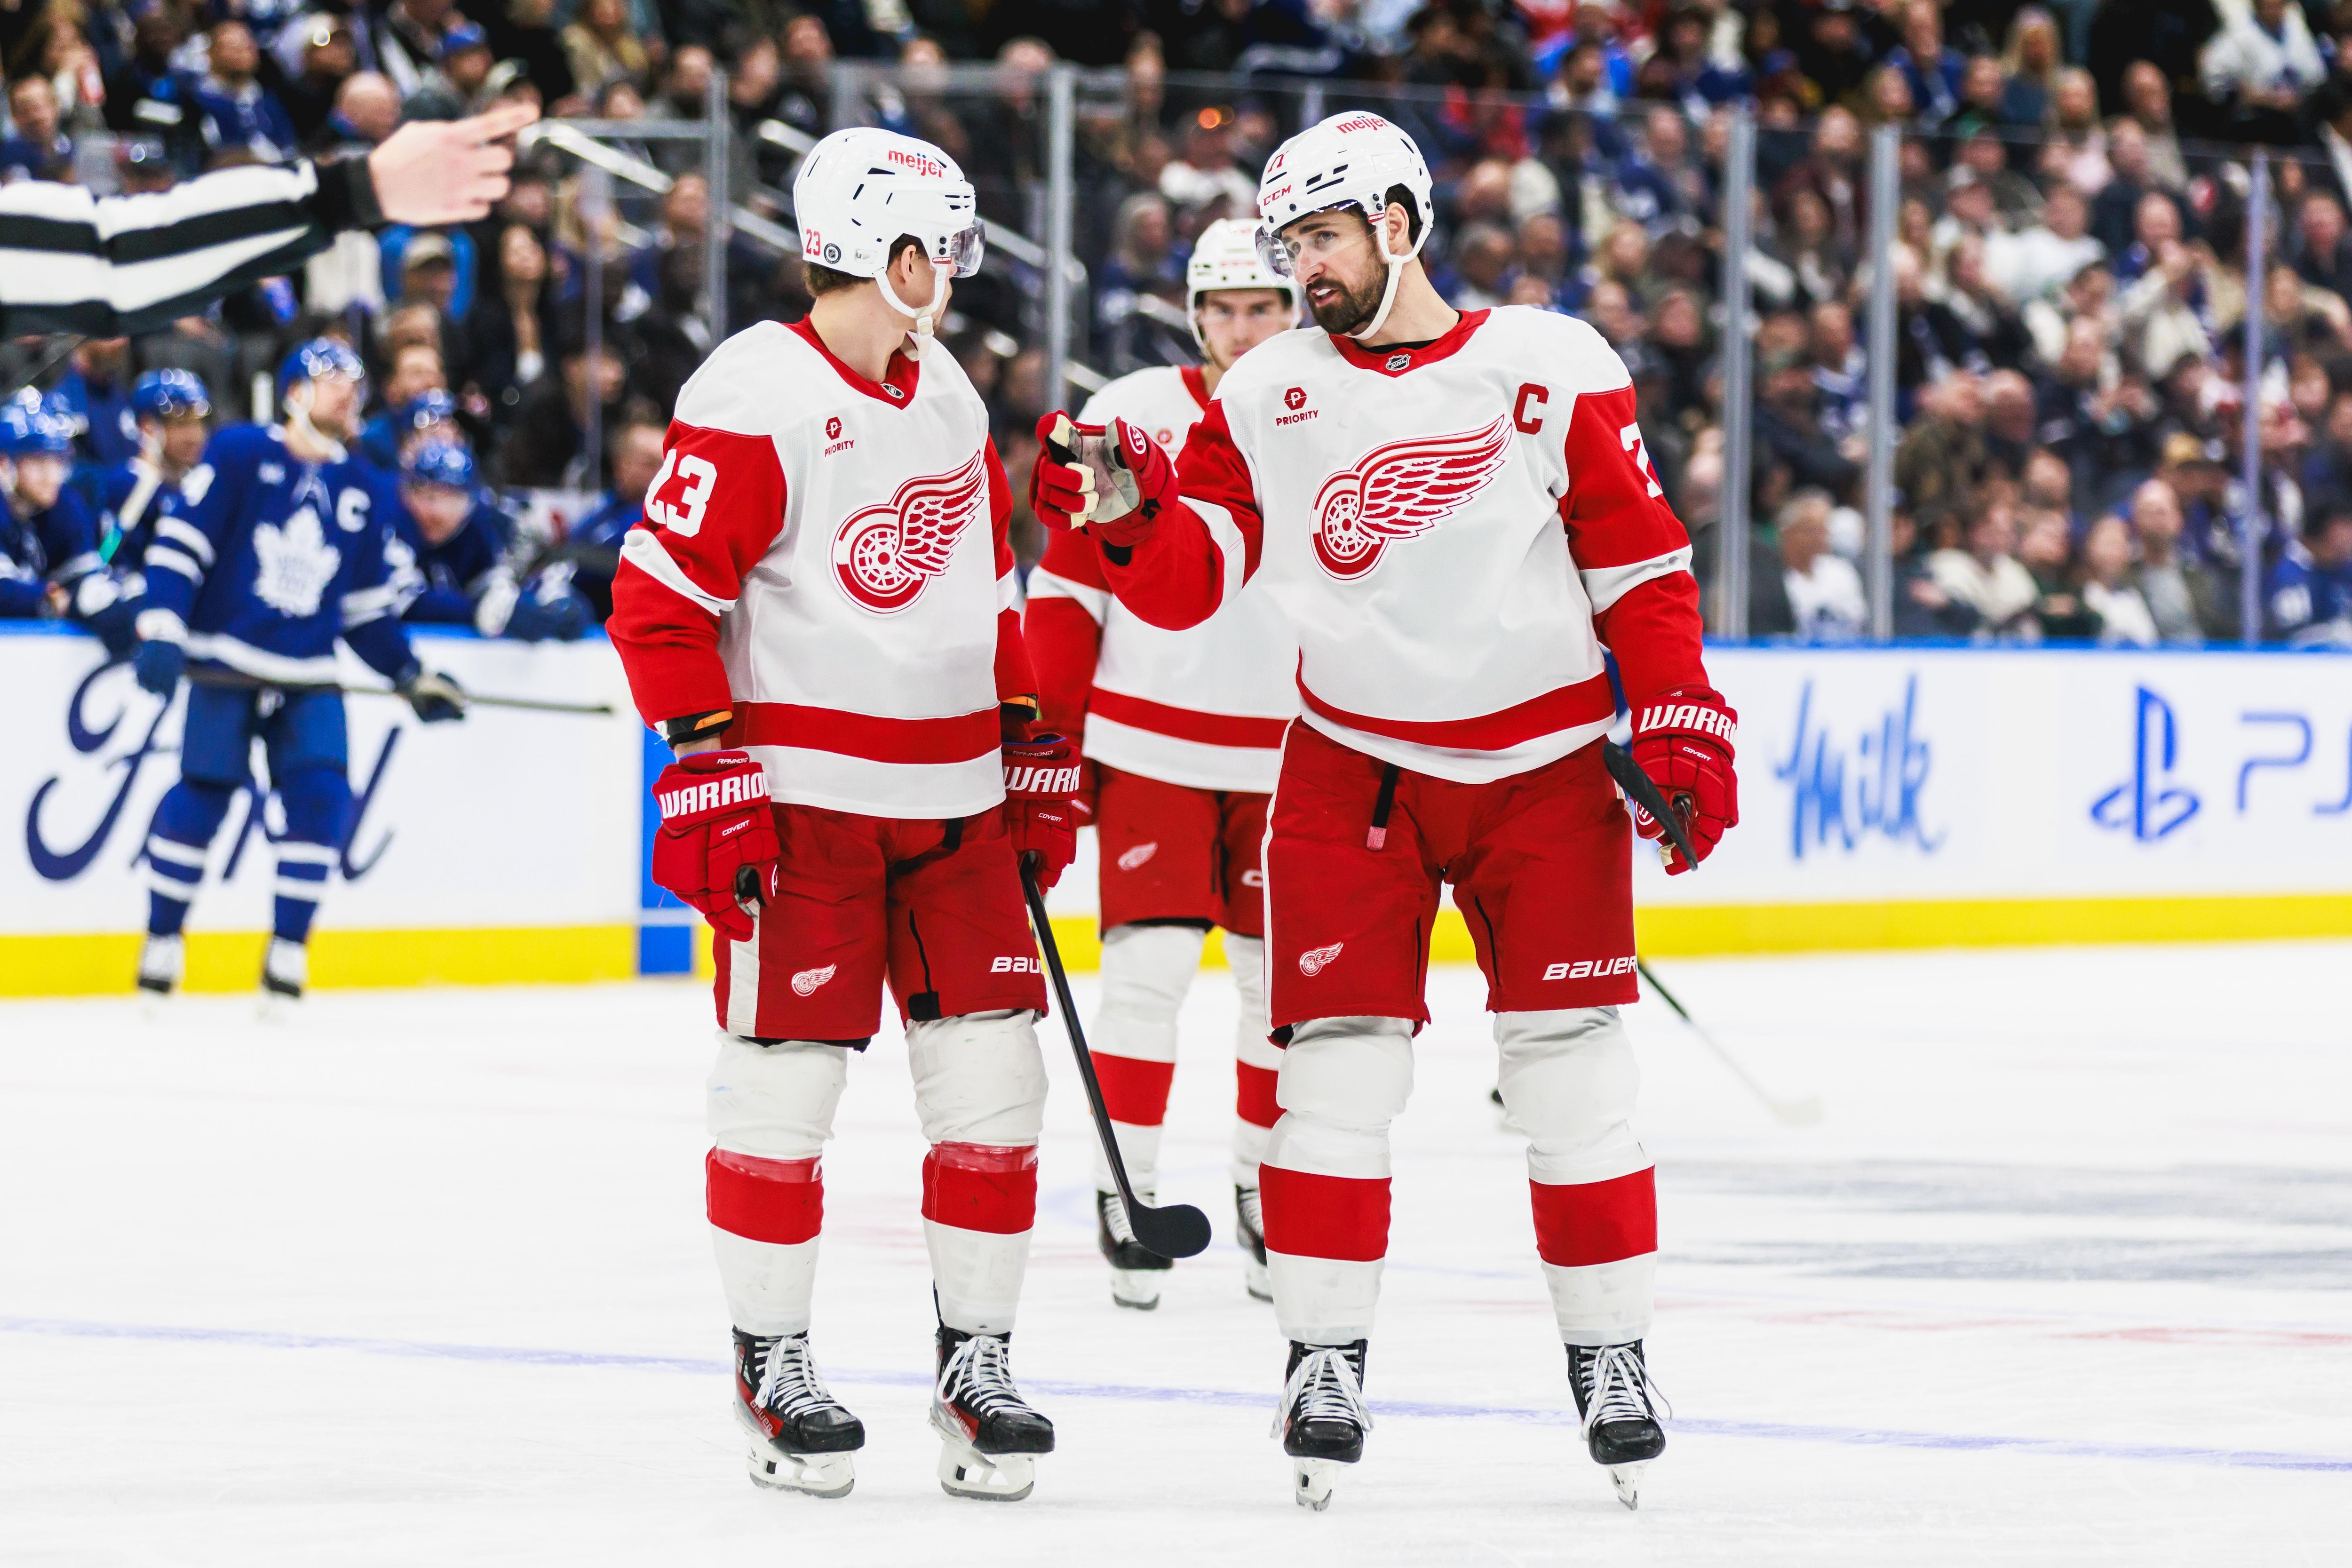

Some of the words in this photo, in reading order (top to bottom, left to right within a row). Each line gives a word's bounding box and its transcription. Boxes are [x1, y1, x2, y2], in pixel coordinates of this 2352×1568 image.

[1336, 115, 1389, 134] meijer
[1263, 184, 1291, 206] CCM
[806, 229, 821, 256] 23
[1276, 409, 1319, 426] PRIORITY
[1513, 382, 1549, 435] C
[825, 439, 855, 457] PRIORITY
[1639, 704, 1739, 747] WARRI
[1683, 746, 1712, 761] COVERT
[1038, 812, 1063, 822] COVERT
[722, 820, 750, 836] COVERT
[990, 956, 1044, 975] BAU
